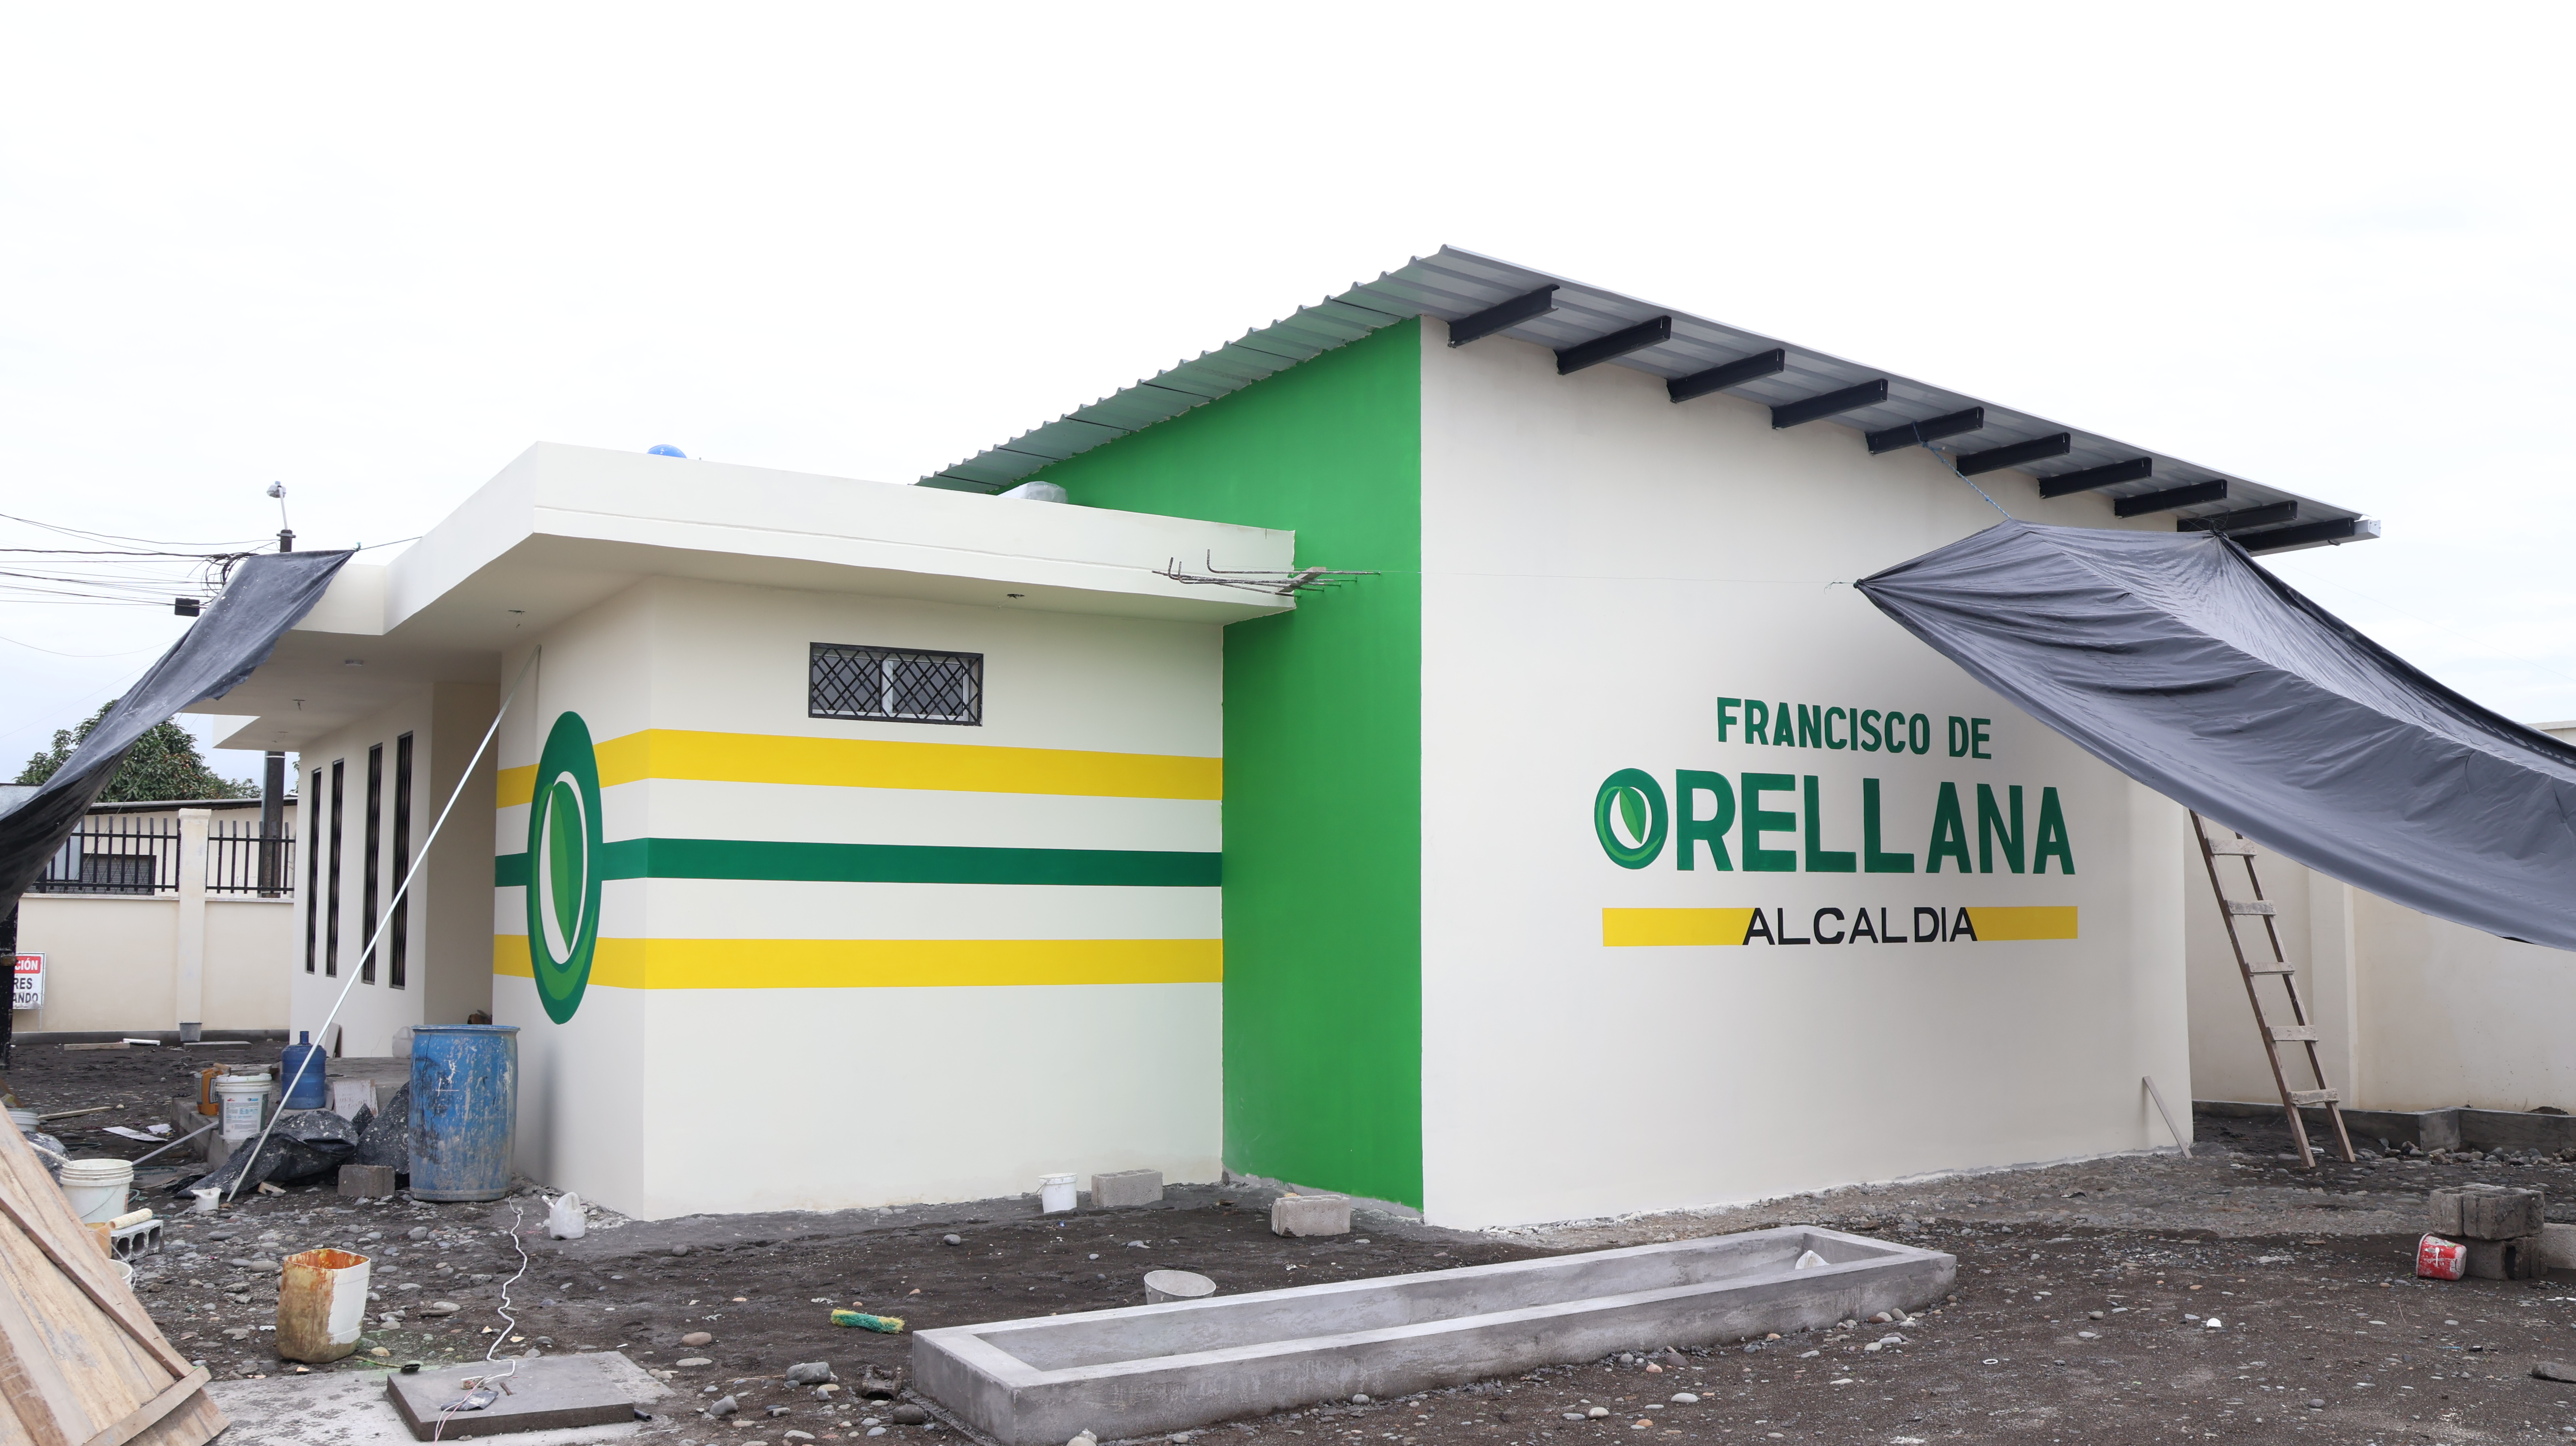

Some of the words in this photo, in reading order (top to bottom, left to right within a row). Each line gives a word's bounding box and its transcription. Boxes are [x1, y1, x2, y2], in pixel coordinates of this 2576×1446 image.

[1717, 697, 1930, 755] FRANCISCO
[1949, 716, 1991, 759] DE
[1594, 768, 2075, 875] ORELLANA
[1743, 907, 1978, 945] ALCALDIA
